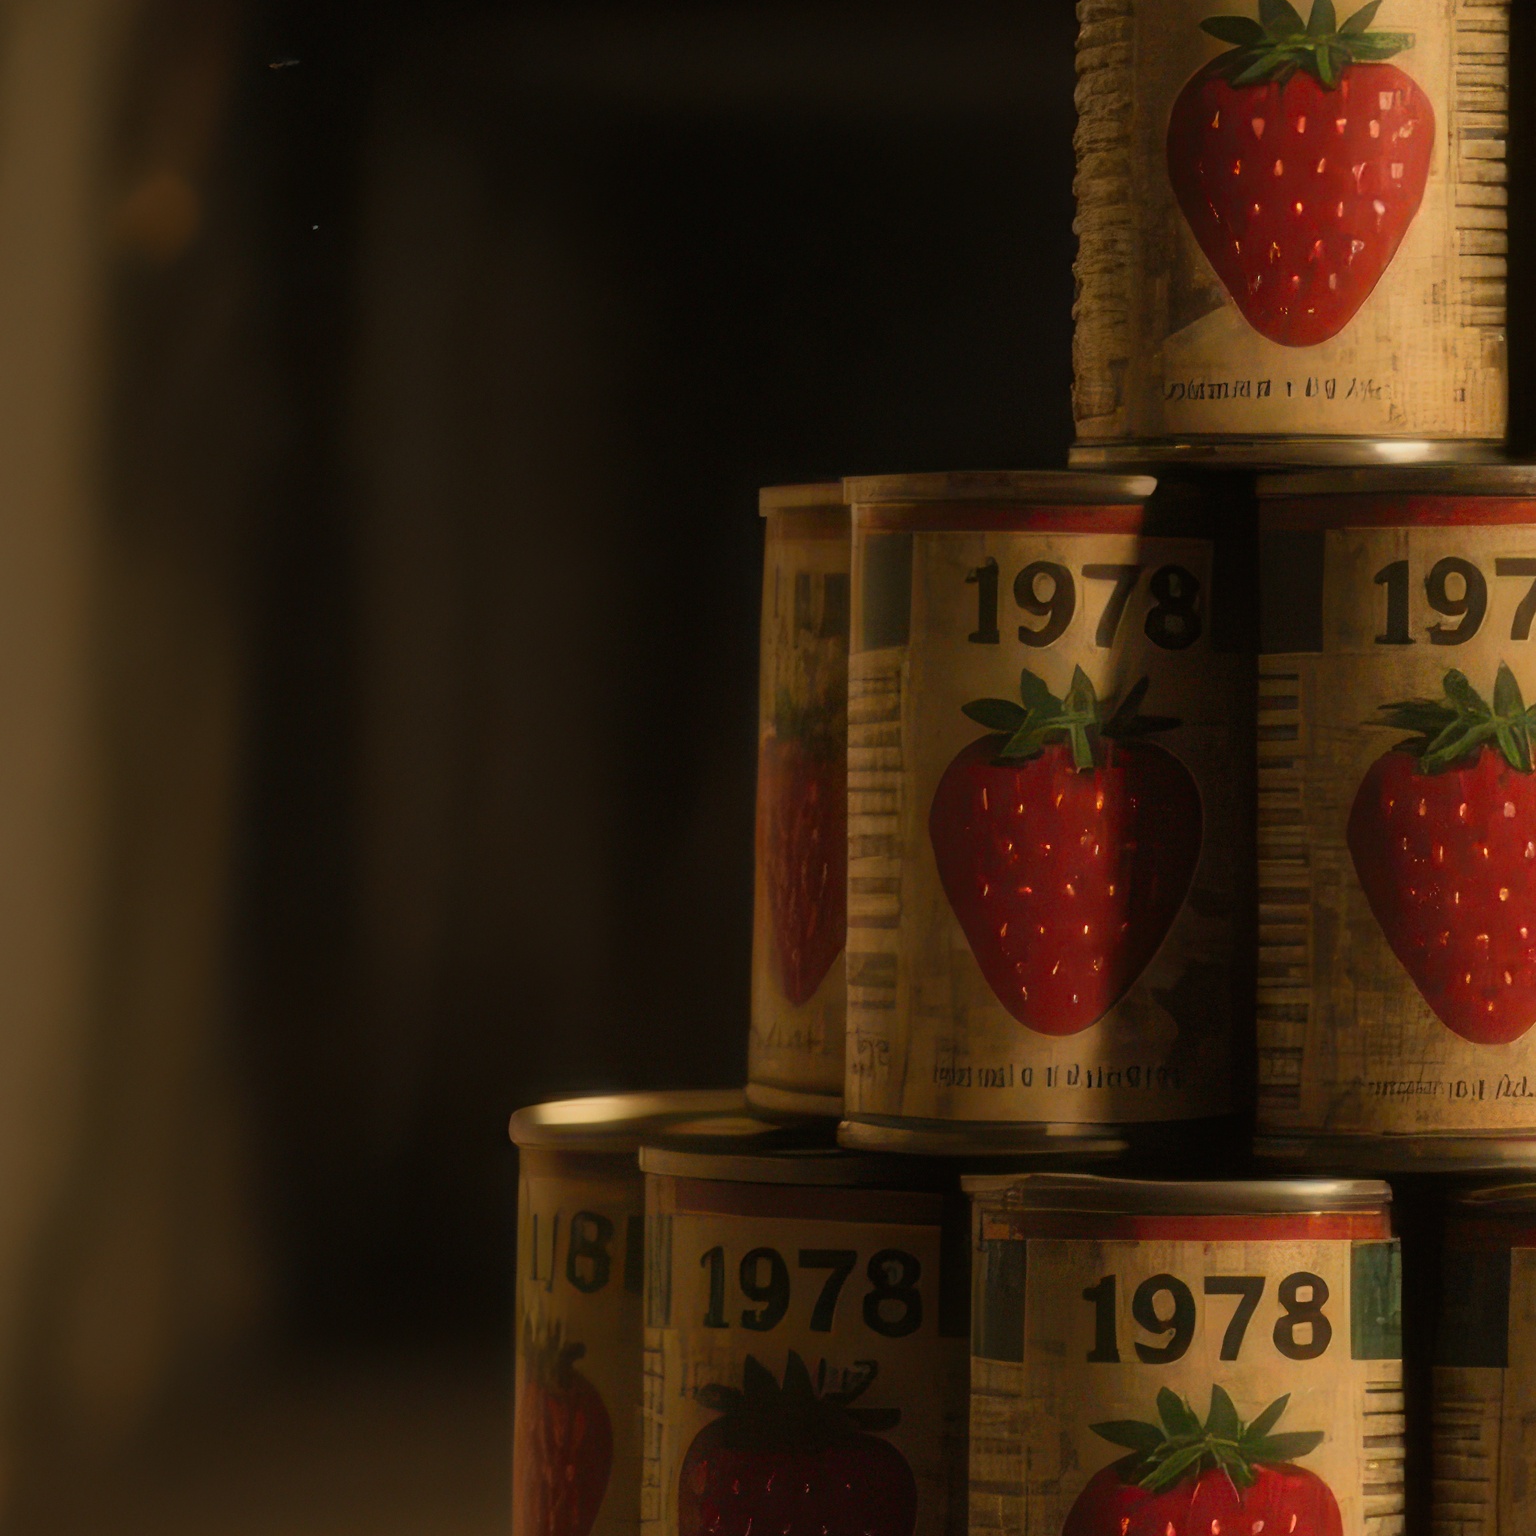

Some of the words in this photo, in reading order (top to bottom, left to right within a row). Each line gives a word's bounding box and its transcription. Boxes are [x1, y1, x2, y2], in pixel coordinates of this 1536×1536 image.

[966, 556, 1203, 650] 1978
[700, 1245, 924, 1338] 1978
[1083, 1272, 1332, 1364] 1978
